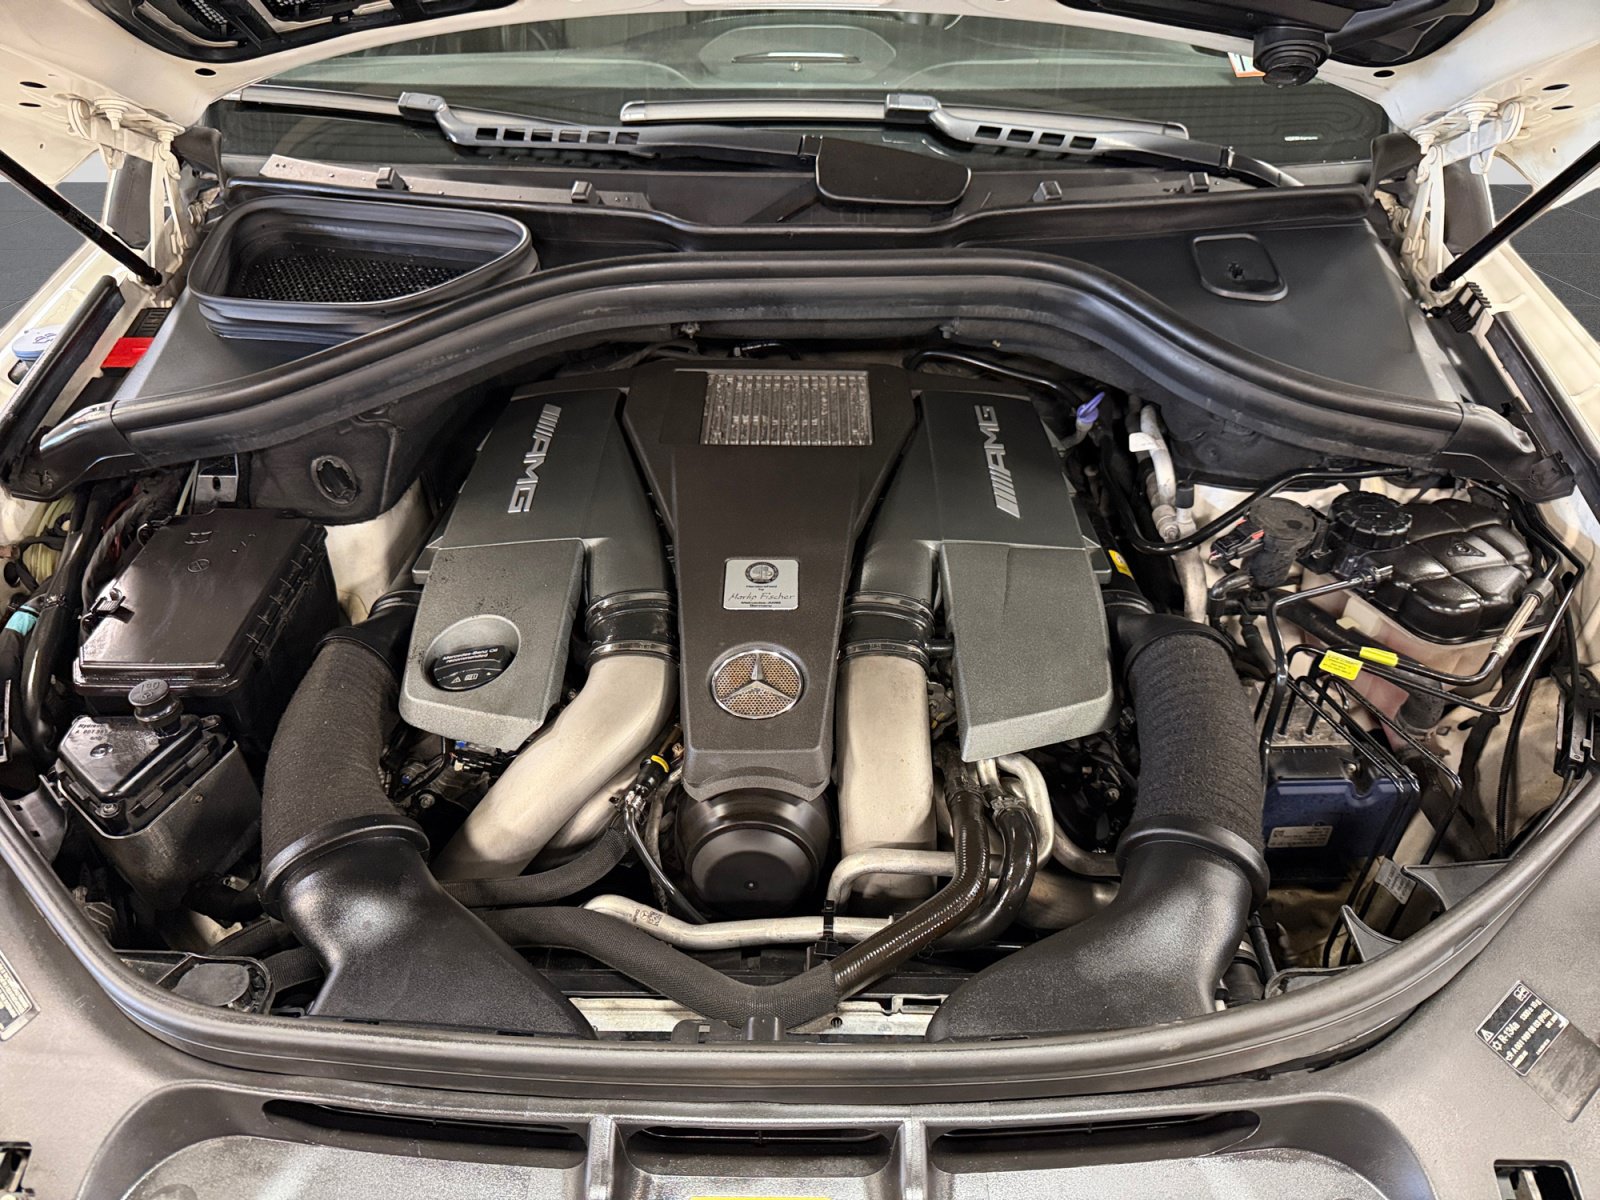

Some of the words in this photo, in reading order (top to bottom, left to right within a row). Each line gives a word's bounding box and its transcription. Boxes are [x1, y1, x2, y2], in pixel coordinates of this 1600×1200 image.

[507, 431, 553, 514] AMG
[759, 592, 796, 601] Fischer
[442, 650, 488, 661] Mercedes-Benz
[1497, 1021, 1521, 1044] R-134a
